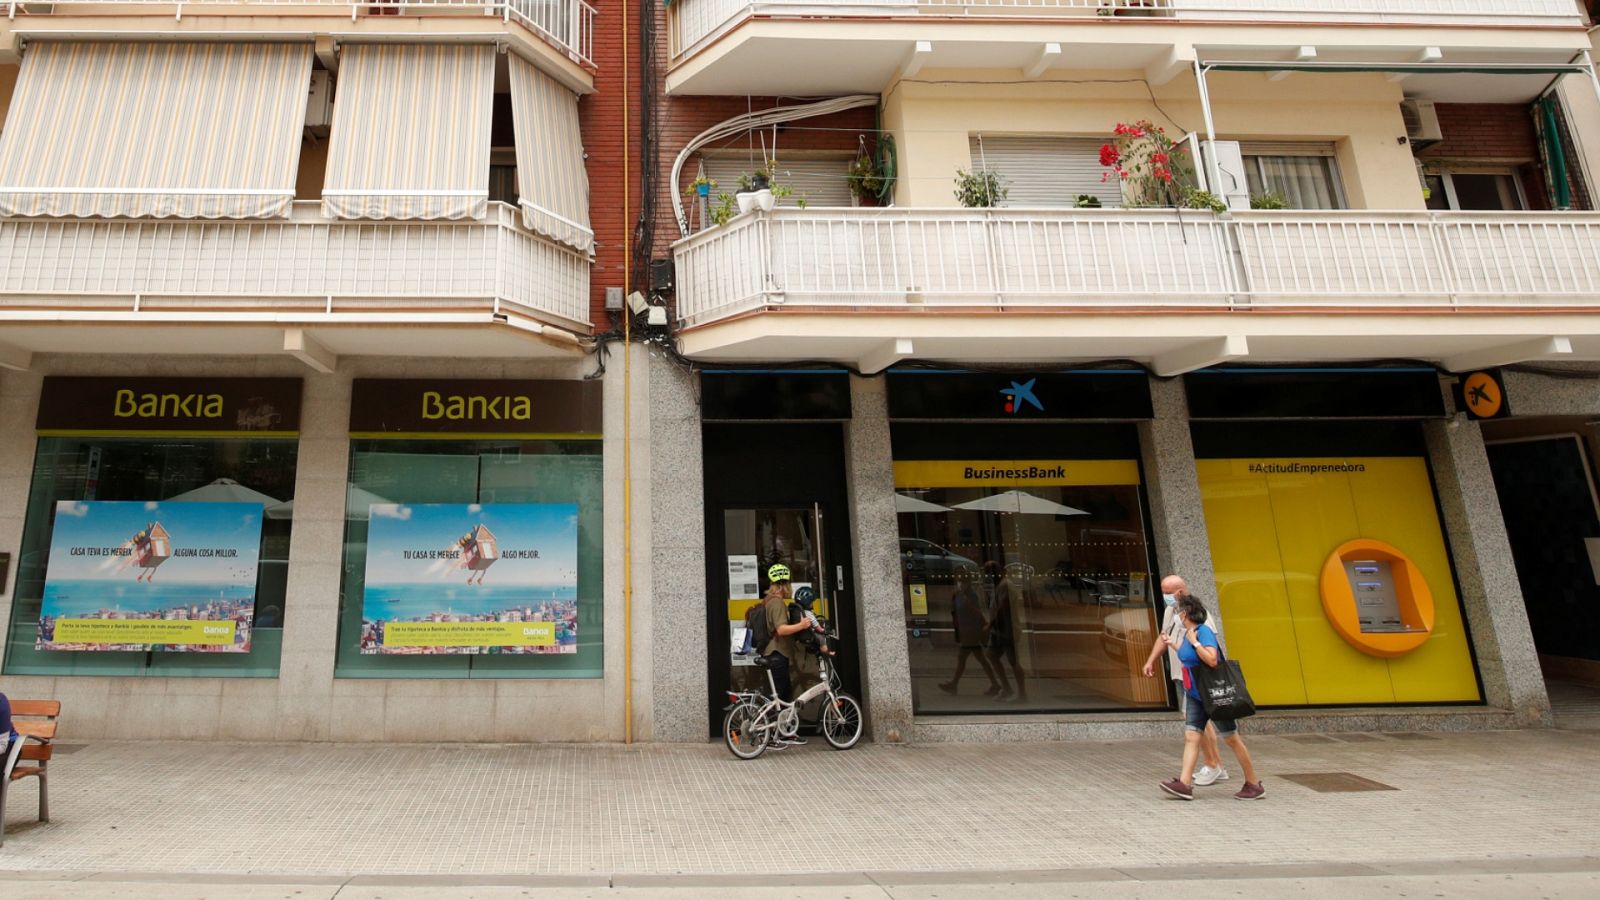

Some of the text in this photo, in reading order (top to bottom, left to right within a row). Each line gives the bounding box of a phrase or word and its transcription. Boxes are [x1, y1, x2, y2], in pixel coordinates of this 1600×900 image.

[114, 389, 223, 418] Bankia
[422, 391, 531, 420] Bankia
[963, 465, 1066, 480] BusinessBank
[1248, 463, 1365, 475] #ActitudEmprenedora
[70, 547, 238, 558] CASA TEVA ES MEREIX ALGUNA COSA MILLOR.
[403, 550, 541, 559] TU CASA SE MERECE ALGO MEJOR.
